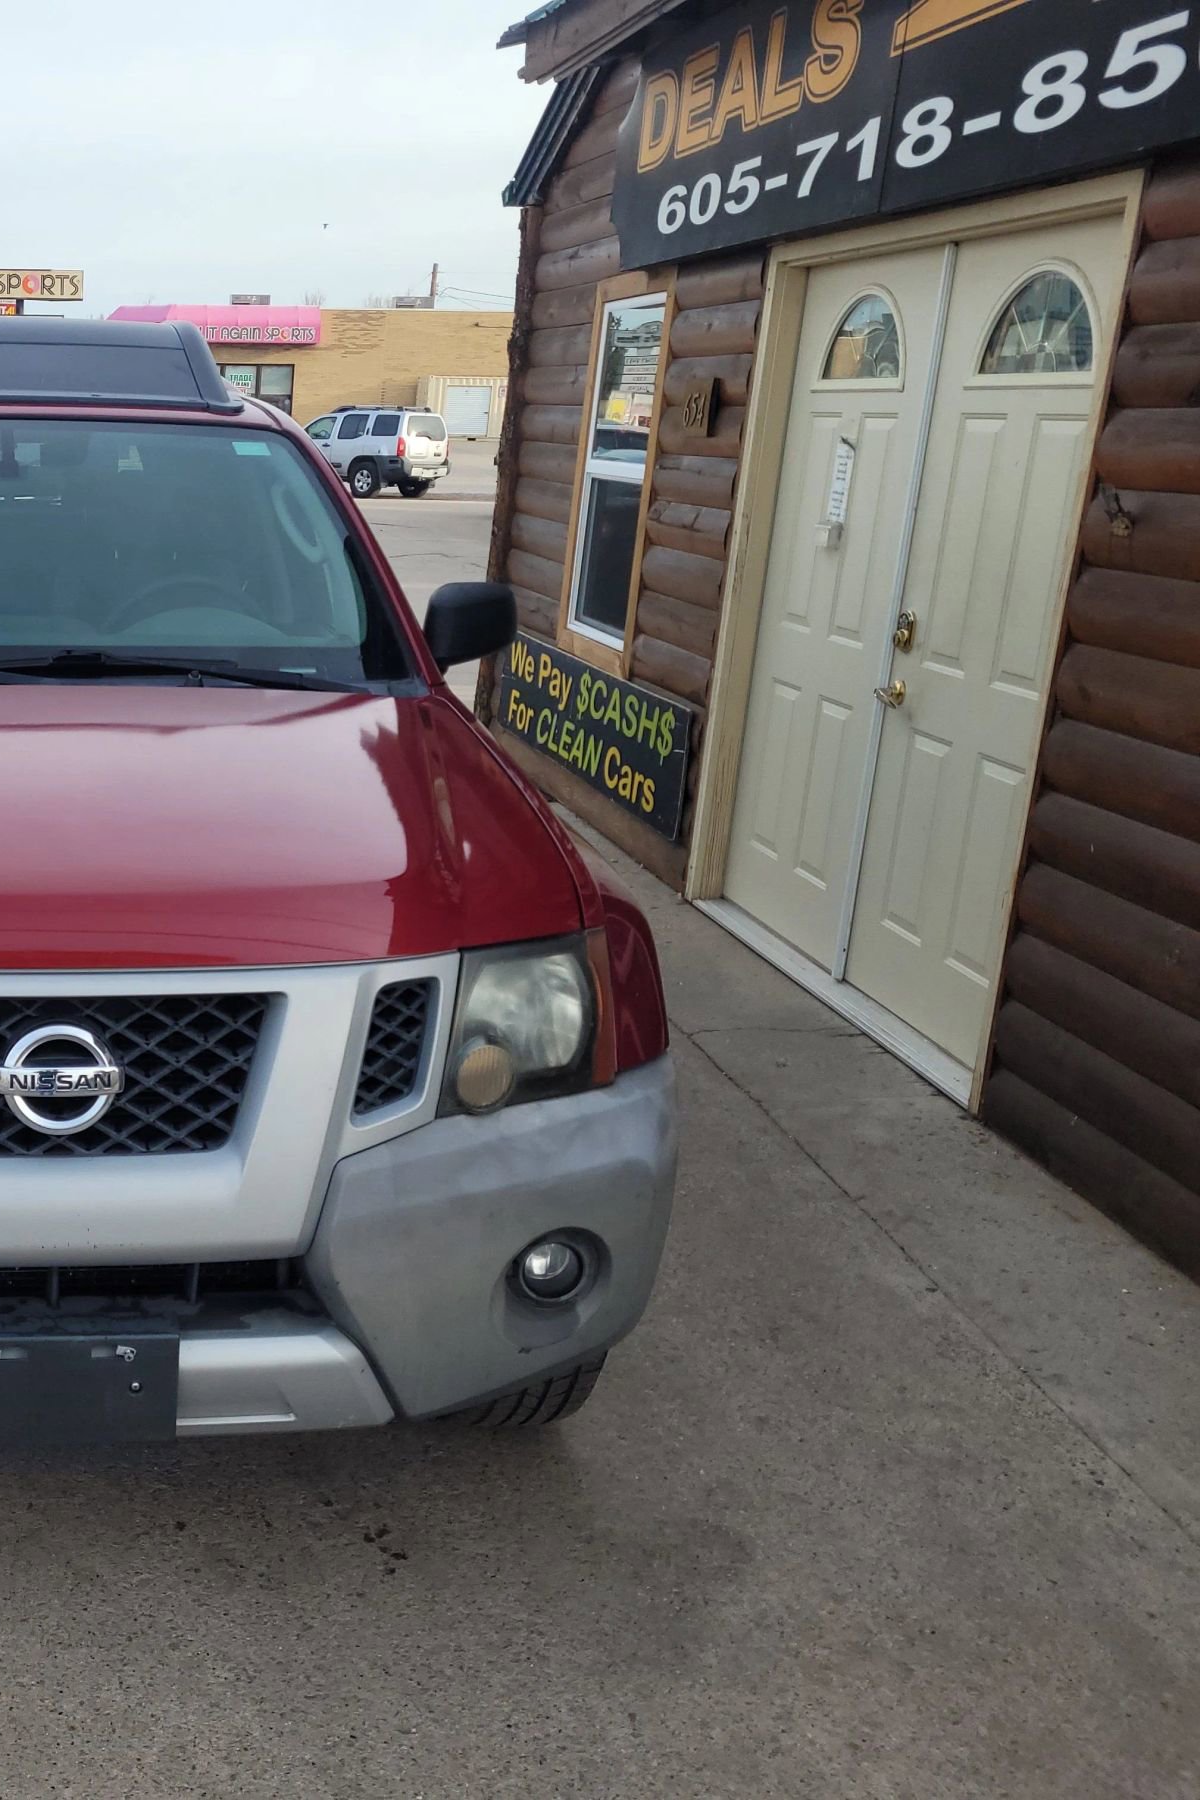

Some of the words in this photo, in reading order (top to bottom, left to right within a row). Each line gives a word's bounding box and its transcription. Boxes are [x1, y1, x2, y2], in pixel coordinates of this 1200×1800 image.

[638, 0, 864, 173] DEALS
[657, 9, 1200, 235] 605-718-85
[205, 327, 218, 340] IT
[221, 327, 261, 340] AGAIN
[265, 327, 314, 340] SPORTS
[683, 392, 707, 428] 654
[508, 689, 534, 735] For
[536, 708, 604, 778] CLEAN
[604, 746, 656, 813] Cars
[511, 640, 535, 683] We
[538, 653, 573, 711] Pay
[576, 668, 676, 767] $CASH$
[9, 1073, 112, 1090] NISSAN
